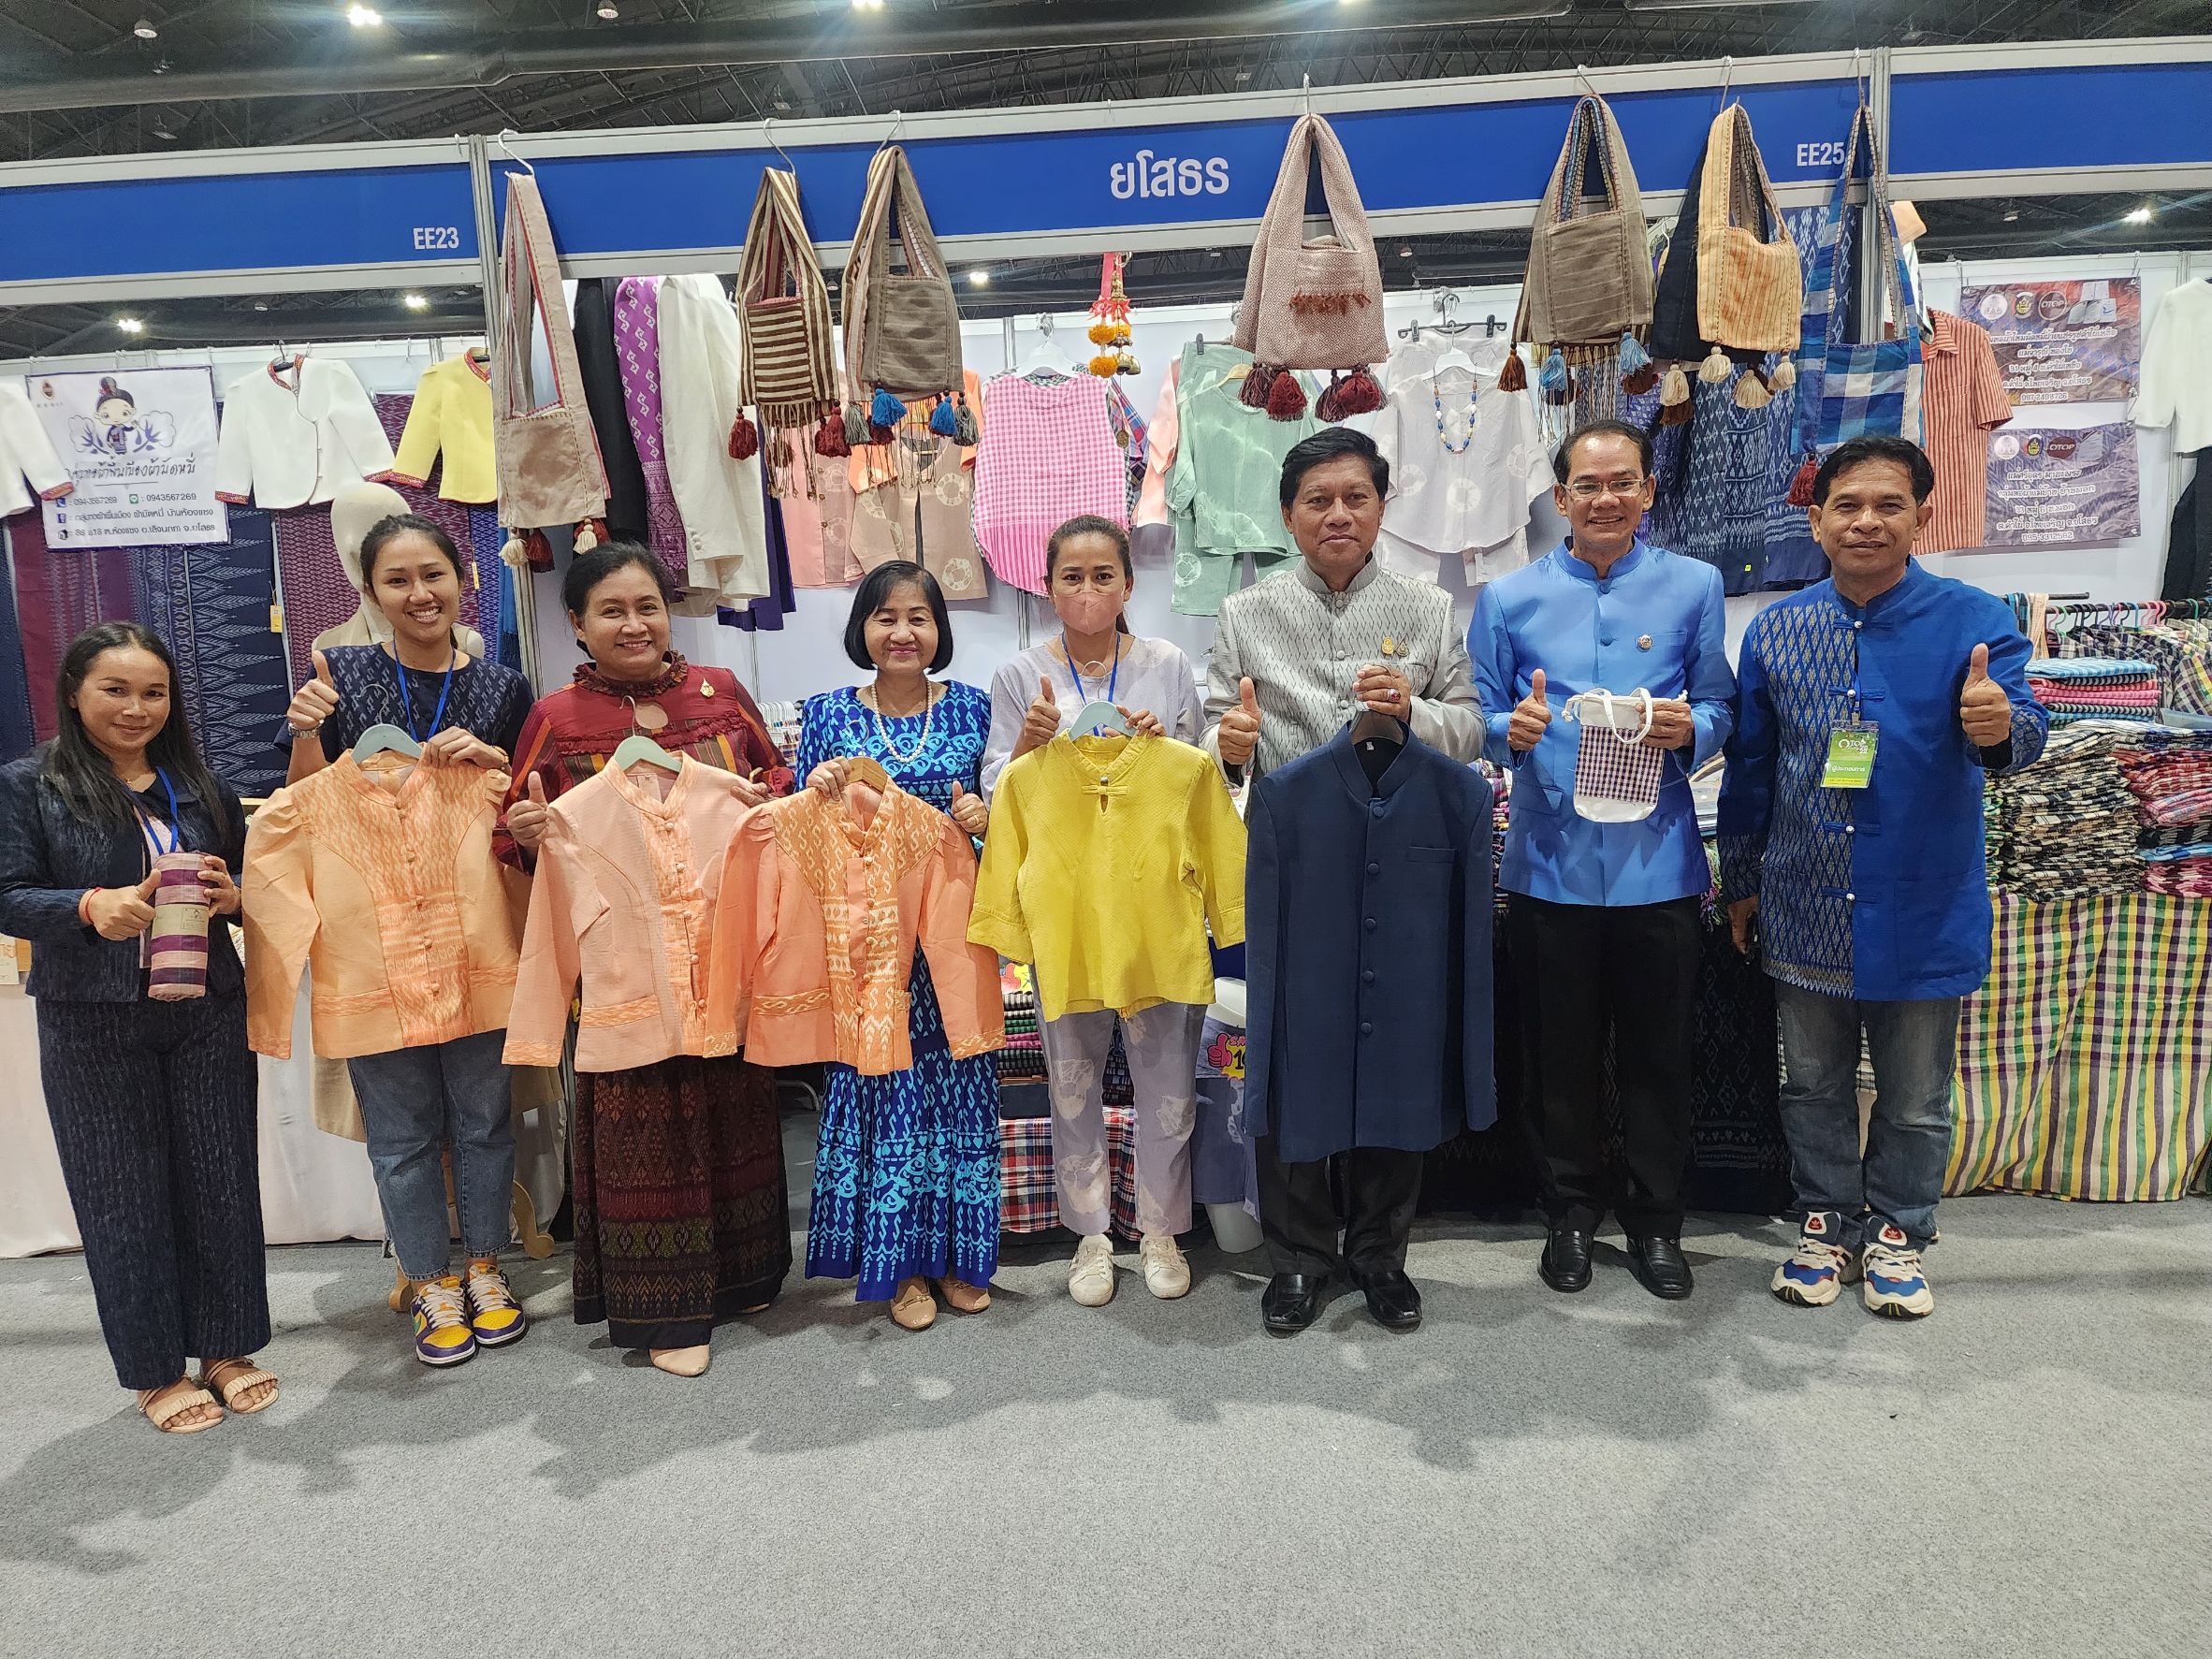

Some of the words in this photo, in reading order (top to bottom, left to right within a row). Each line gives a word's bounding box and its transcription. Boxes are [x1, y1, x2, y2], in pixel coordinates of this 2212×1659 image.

[1797, 141, 1845, 167] EE25
[1110, 149, 1230, 199] ยโสธร
[414, 226, 459, 250] EE23
[146, 492, 196, 502] 0943567269
[183, 523, 216, 532] จ.ยโสธร
